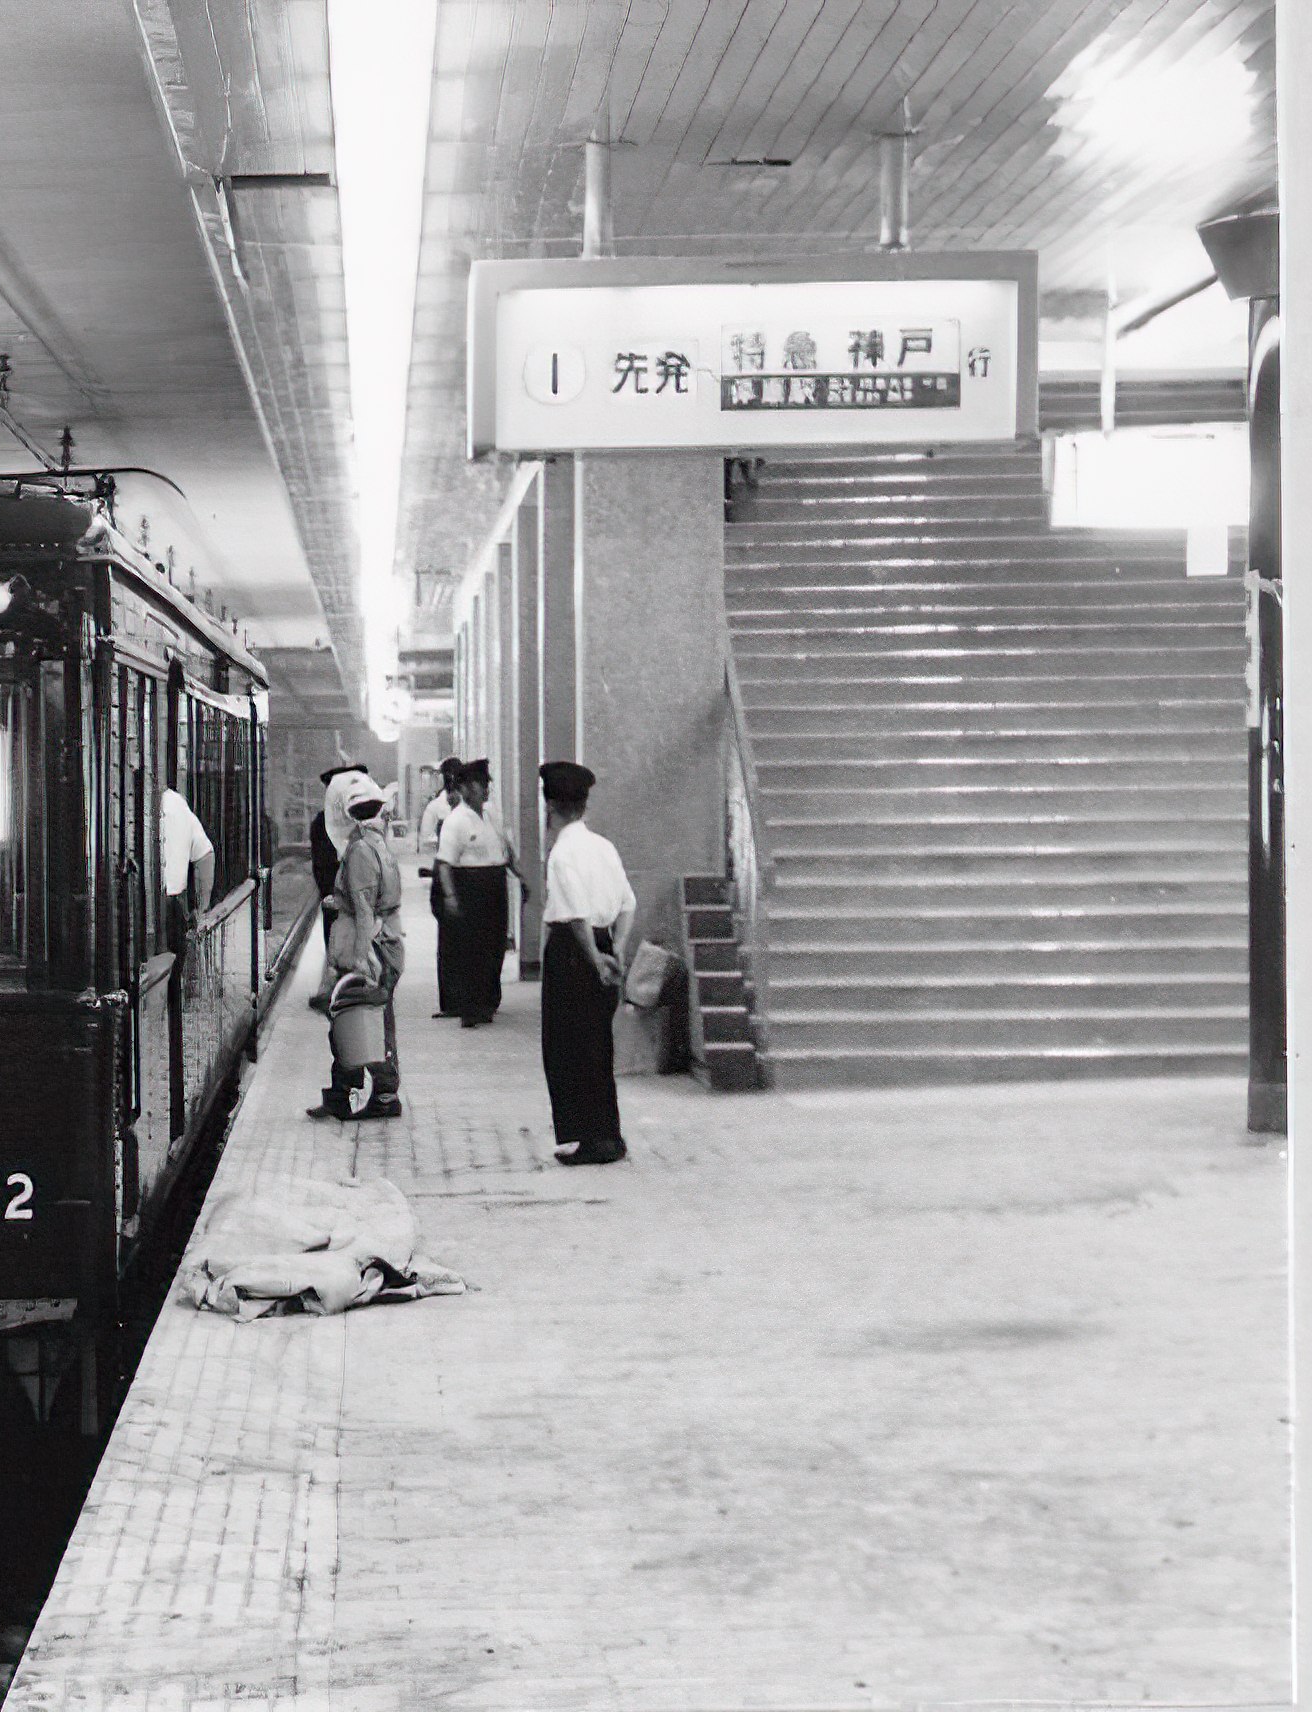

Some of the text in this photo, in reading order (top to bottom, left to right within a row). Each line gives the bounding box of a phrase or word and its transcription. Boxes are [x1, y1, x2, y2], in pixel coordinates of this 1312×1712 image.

[612, 351, 691, 394] 先発
[847, 328, 933, 369] 神戸
[968, 347, 991, 378] 行
